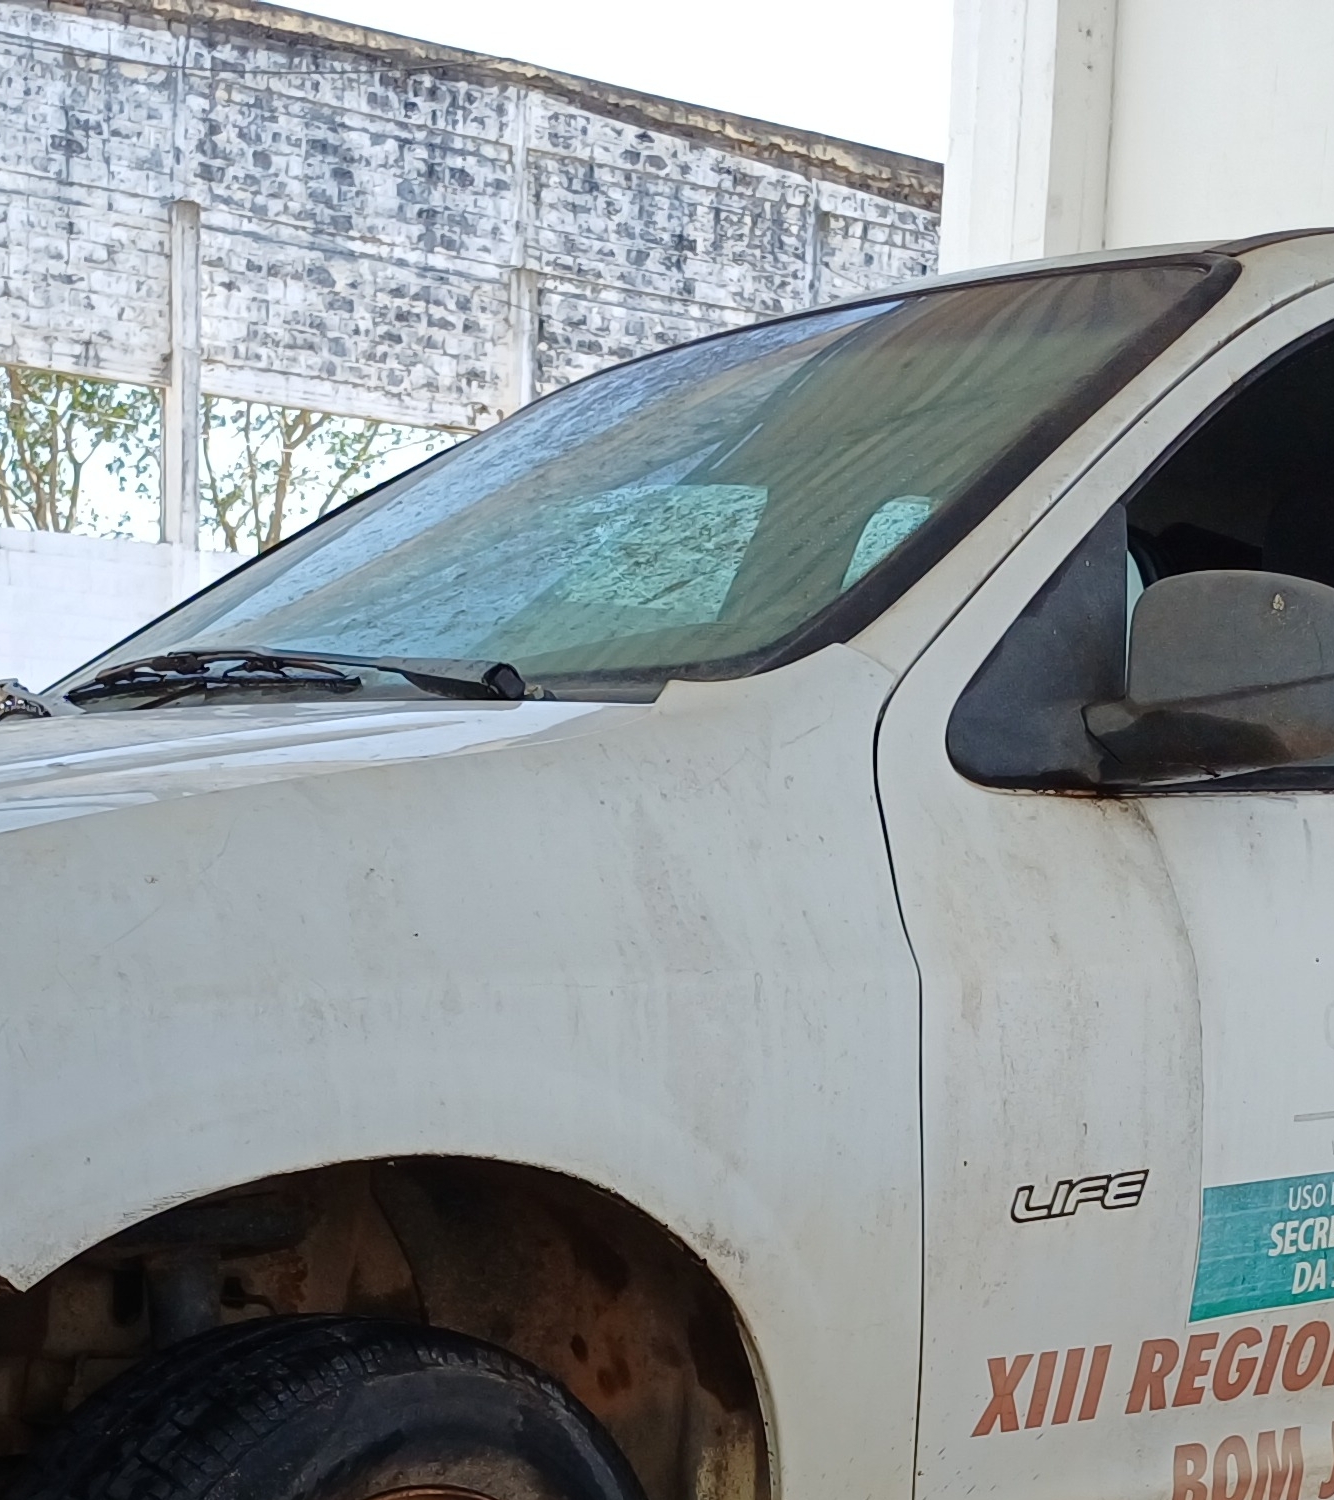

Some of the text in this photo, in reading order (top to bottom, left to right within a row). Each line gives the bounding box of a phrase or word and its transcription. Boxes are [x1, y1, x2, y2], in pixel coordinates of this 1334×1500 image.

[1010, 1168, 1150, 1223] LIFE
[1289, 1182, 1327, 1212] USO
[1291, 1260, 1326, 1295] DA
[970, 1343, 1113, 1438] XIII
